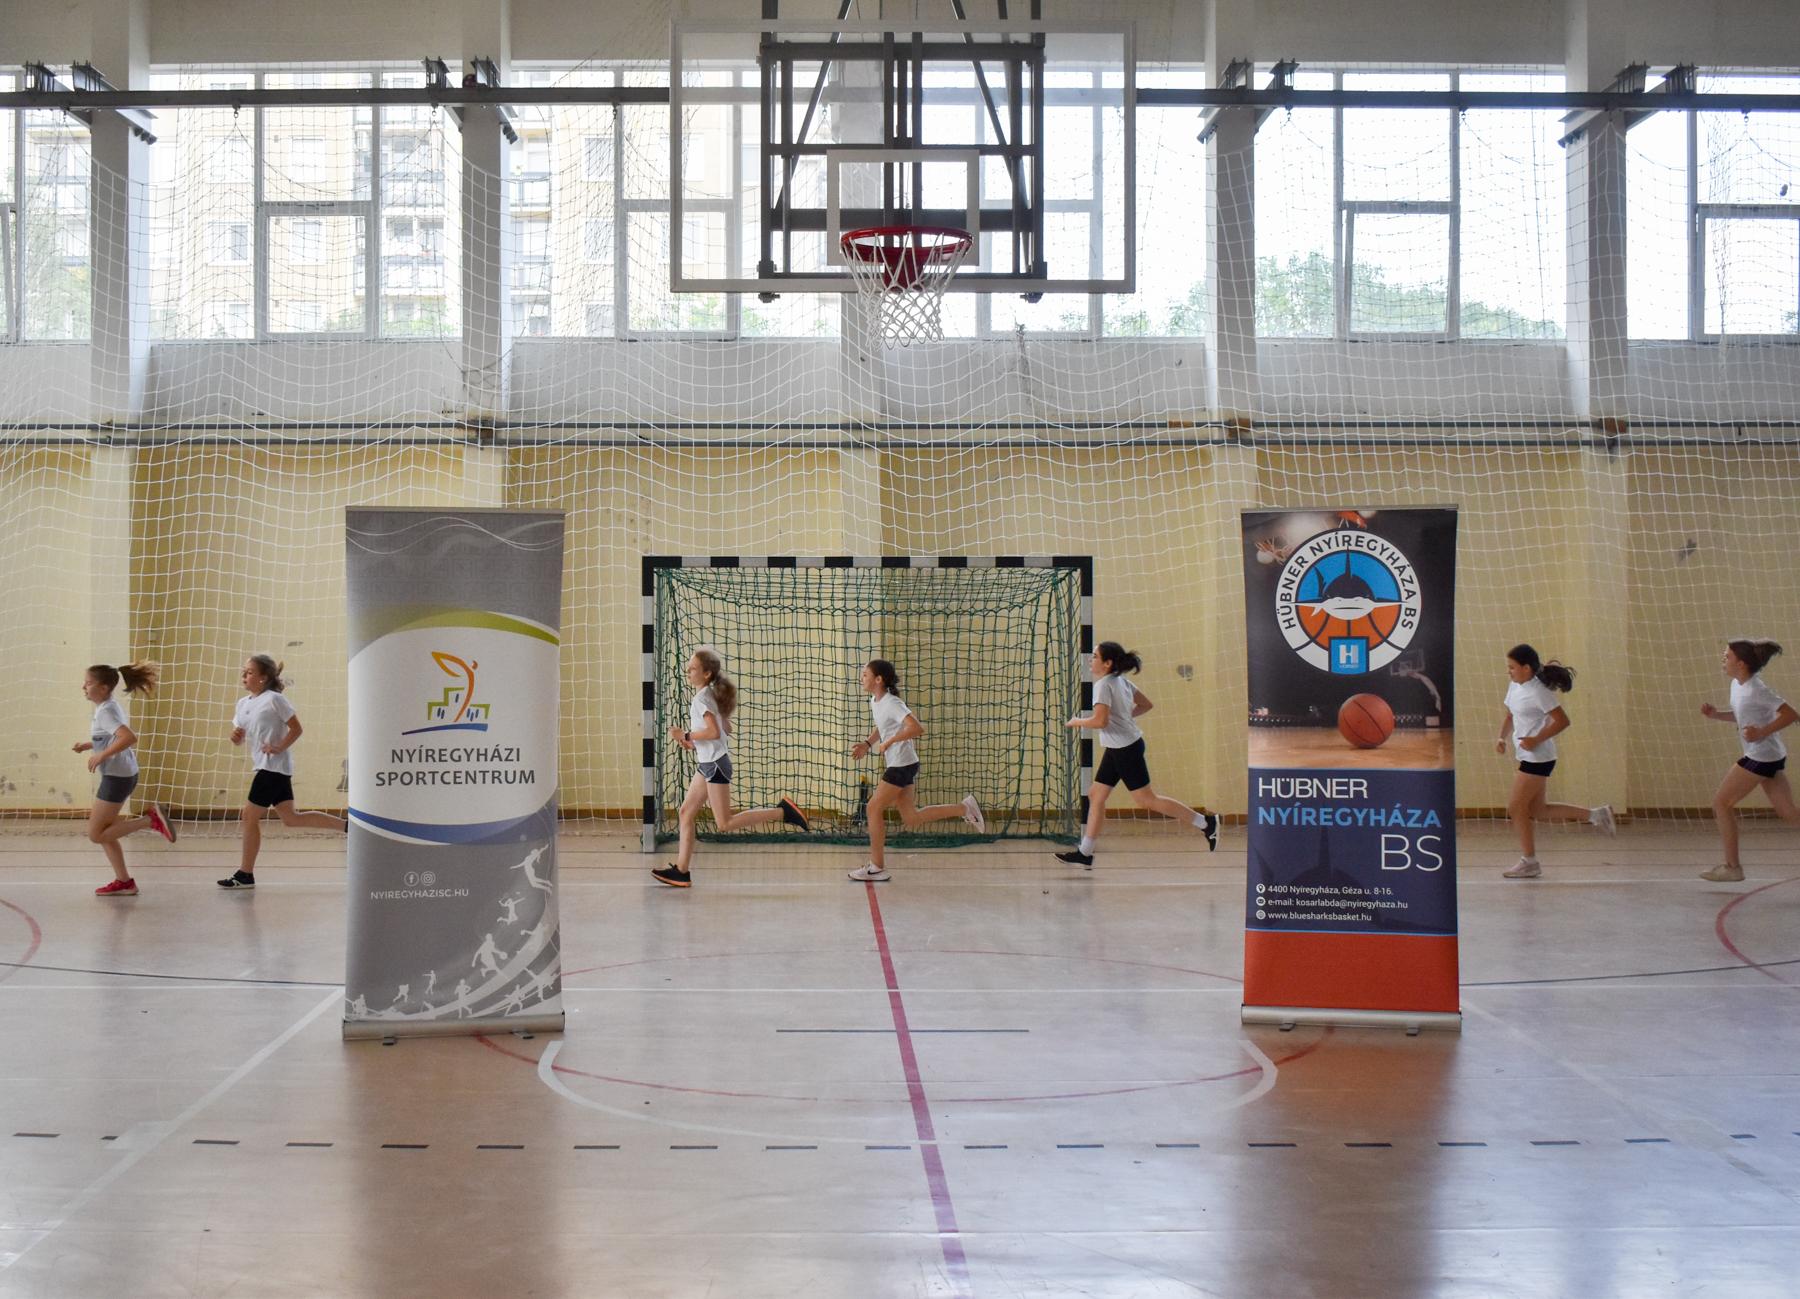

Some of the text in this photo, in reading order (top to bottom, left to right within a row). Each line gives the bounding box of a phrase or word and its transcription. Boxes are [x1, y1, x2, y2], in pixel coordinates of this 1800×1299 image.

[1277, 532, 1417, 630] HÜBNER NYÍREGYHÁZA BS
[1339, 644, 1359, 664] H
[391, 744, 521, 764] NYÍREGYHÁZI
[375, 769, 536, 787] SPORTCENTRUM
[1258, 777, 1368, 799] HÜBNER
[1258, 802, 1442, 828] NYÍREGYHÁZA
[1381, 834, 1443, 872] BS
[370, 888, 470, 901] NYIREGYHAZISC.HU
[1267, 885, 1288, 894] 4400
[1342, 886, 1362, 895] Géza
[1373, 887, 1394, 896] 8-16.
[1267, 898, 1408, 910] e-mail: kosarlabda@nyiregyhaza.hu
[1267, 911, 1372, 921] www.bluesharksbasket.hu
